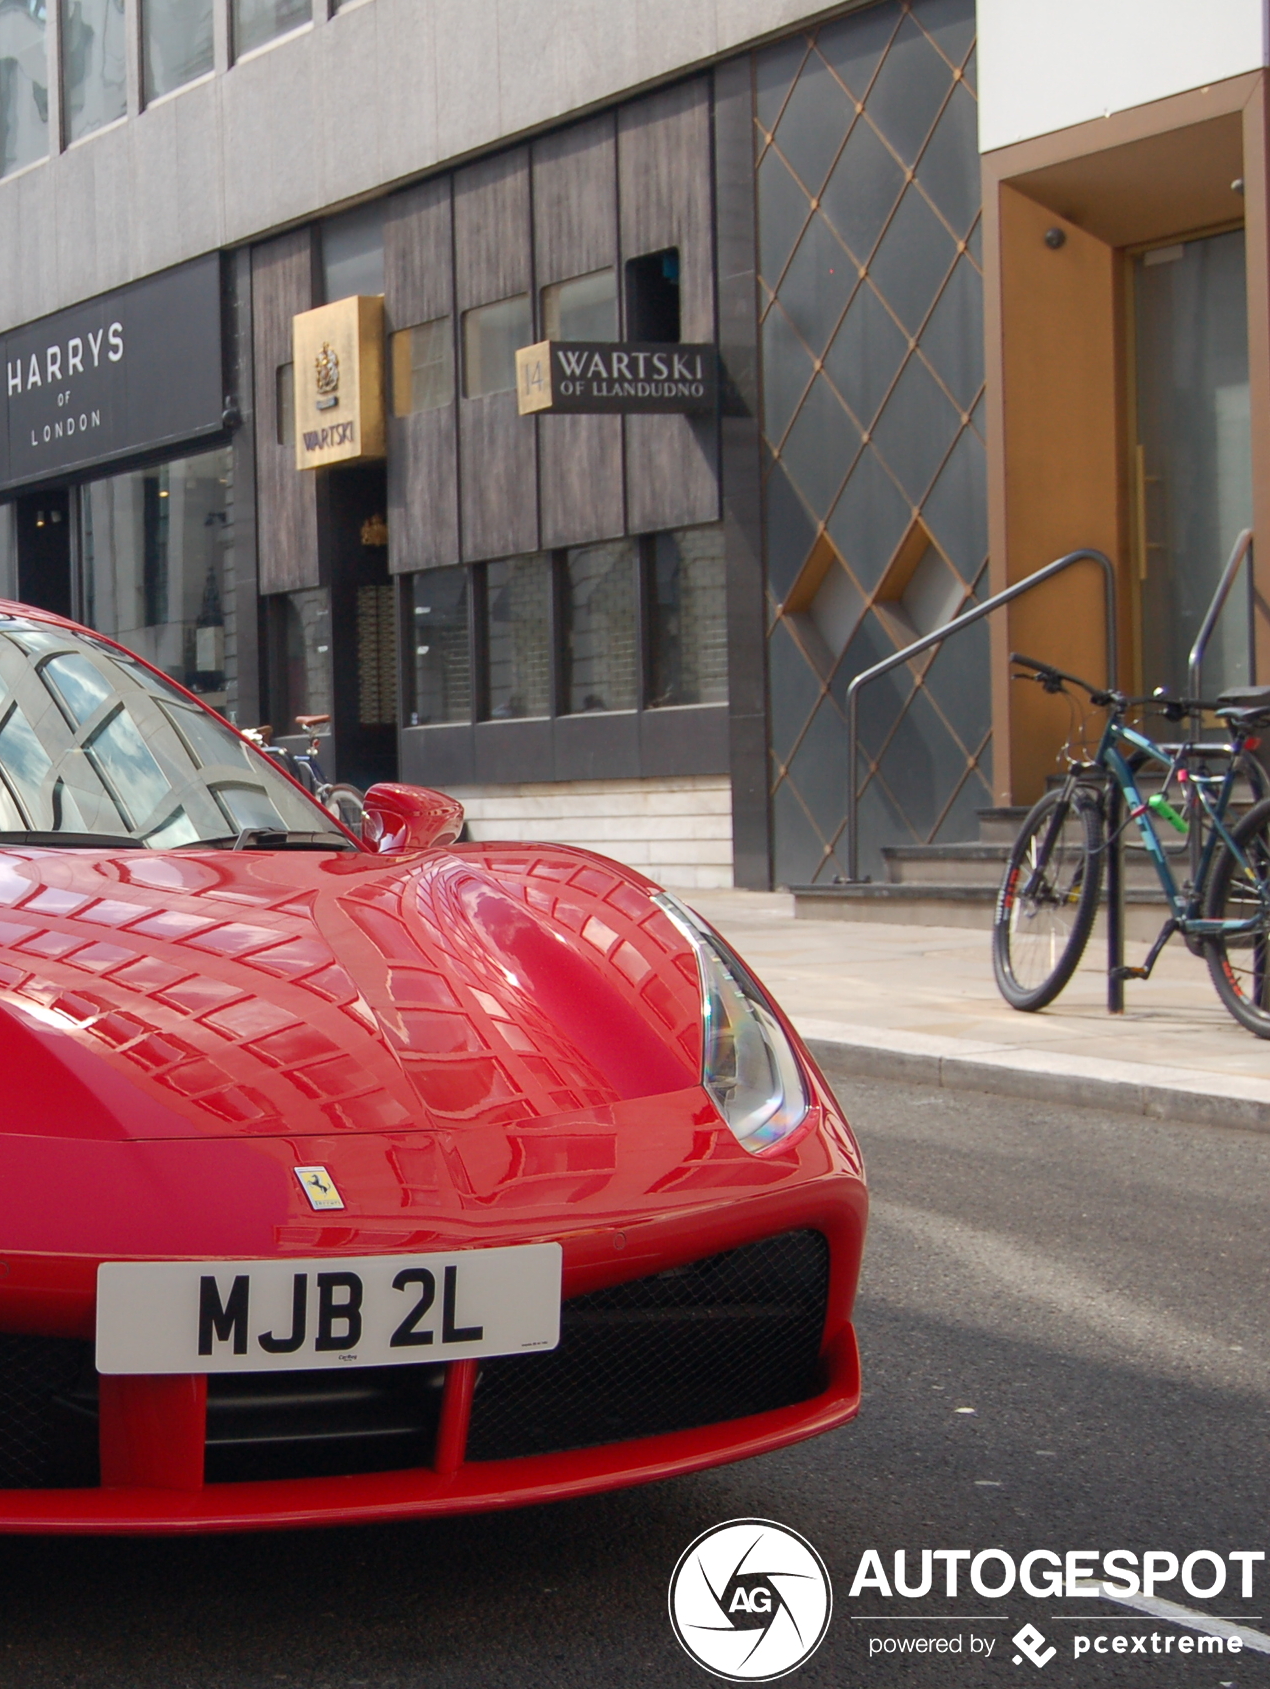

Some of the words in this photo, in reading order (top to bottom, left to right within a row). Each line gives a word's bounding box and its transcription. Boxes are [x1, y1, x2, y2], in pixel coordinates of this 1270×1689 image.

[7, 321, 124, 397] HARRYS
[557, 350, 703, 381] WARTSKI
[523, 360, 544, 396] 14
[560, 380, 585, 396] OF
[593, 381, 705, 398] LLANDUDNO
[57, 390, 71, 407] OF
[31, 409, 101, 446] LONDON
[303, 420, 354, 452] WARTSKI
[197, 1269, 364, 1357] MJB
[390, 1264, 484, 1349] 2L
